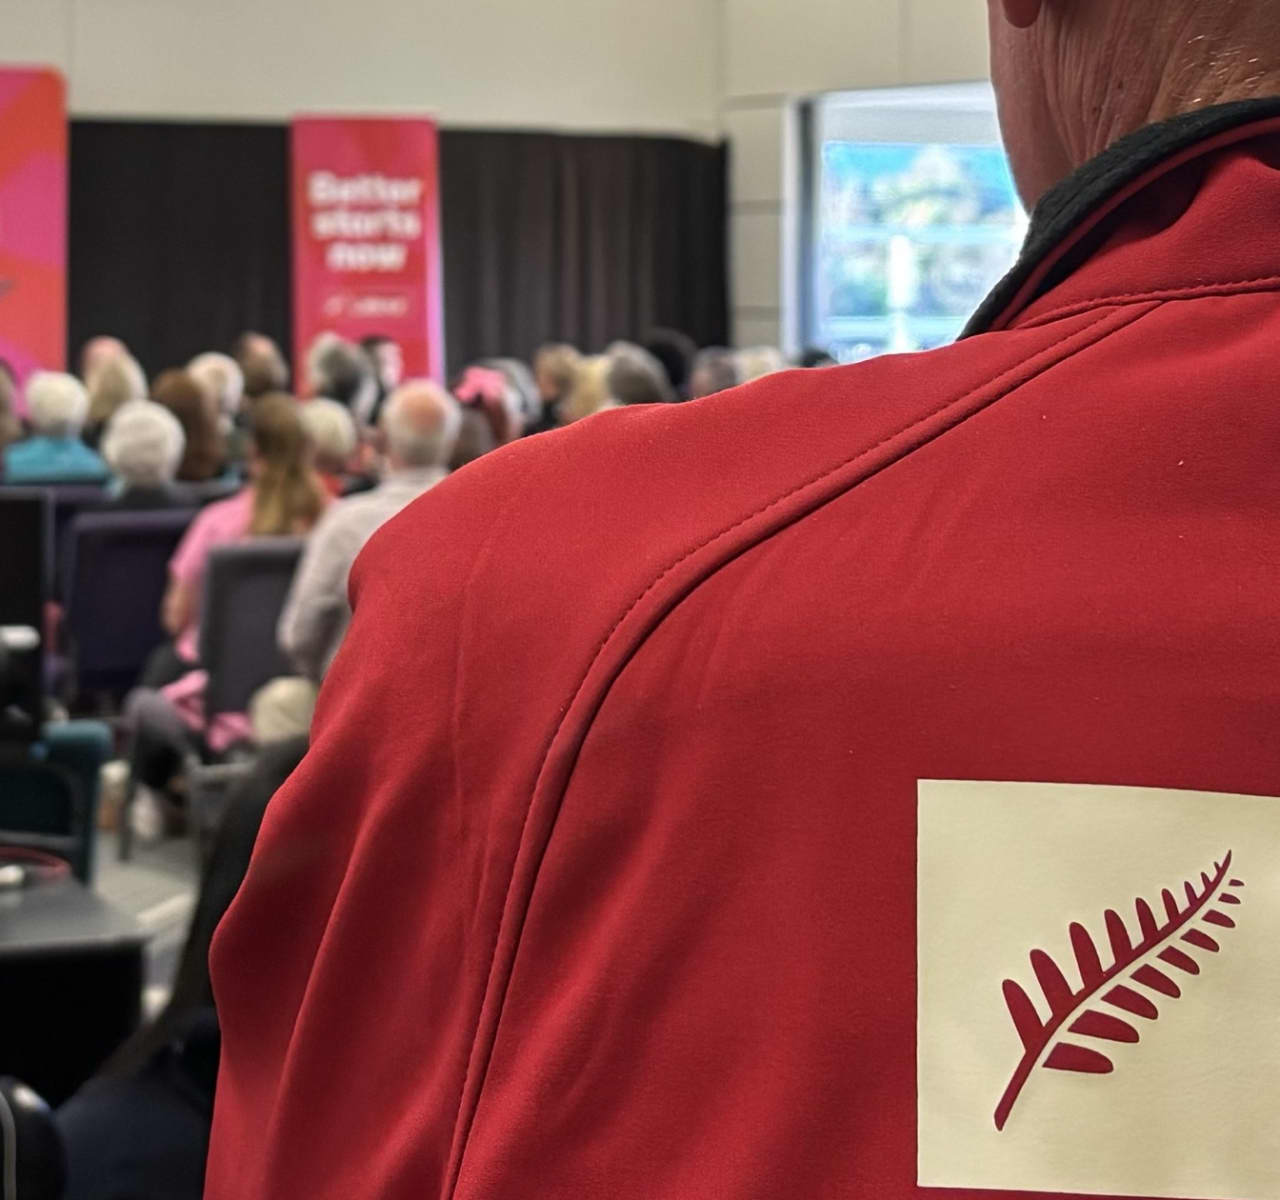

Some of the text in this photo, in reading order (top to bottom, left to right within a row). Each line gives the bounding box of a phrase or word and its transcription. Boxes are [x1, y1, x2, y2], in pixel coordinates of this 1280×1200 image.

[308, 170, 422, 206] Better
[311, 209, 421, 240] starts
[324, 242, 406, 271] now
